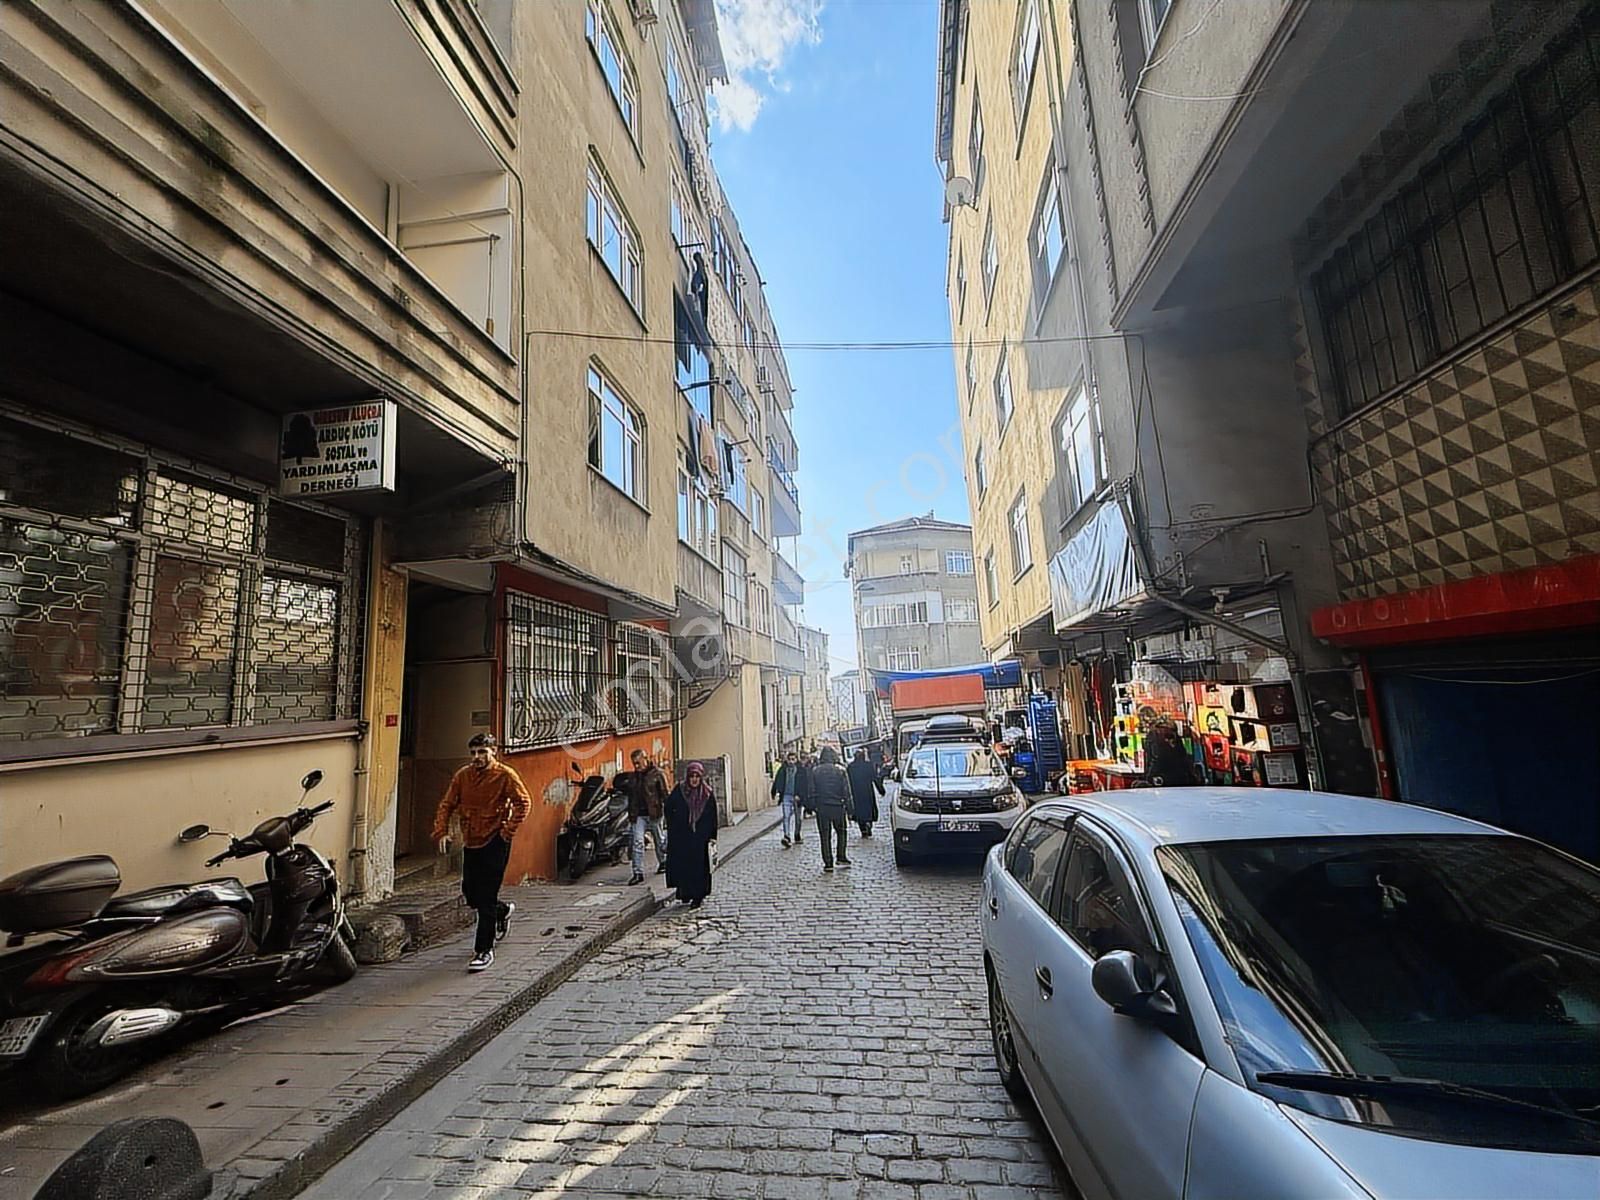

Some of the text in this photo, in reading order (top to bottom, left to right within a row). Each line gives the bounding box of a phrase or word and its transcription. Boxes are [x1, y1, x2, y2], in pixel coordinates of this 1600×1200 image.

[352, 420, 379, 439] KÖYÜ
[325, 445, 368, 461] SOSYAL ve
[283, 460, 378, 479] YARDIMLAŞMA
[301, 475, 359, 493] DERNEĞİ
